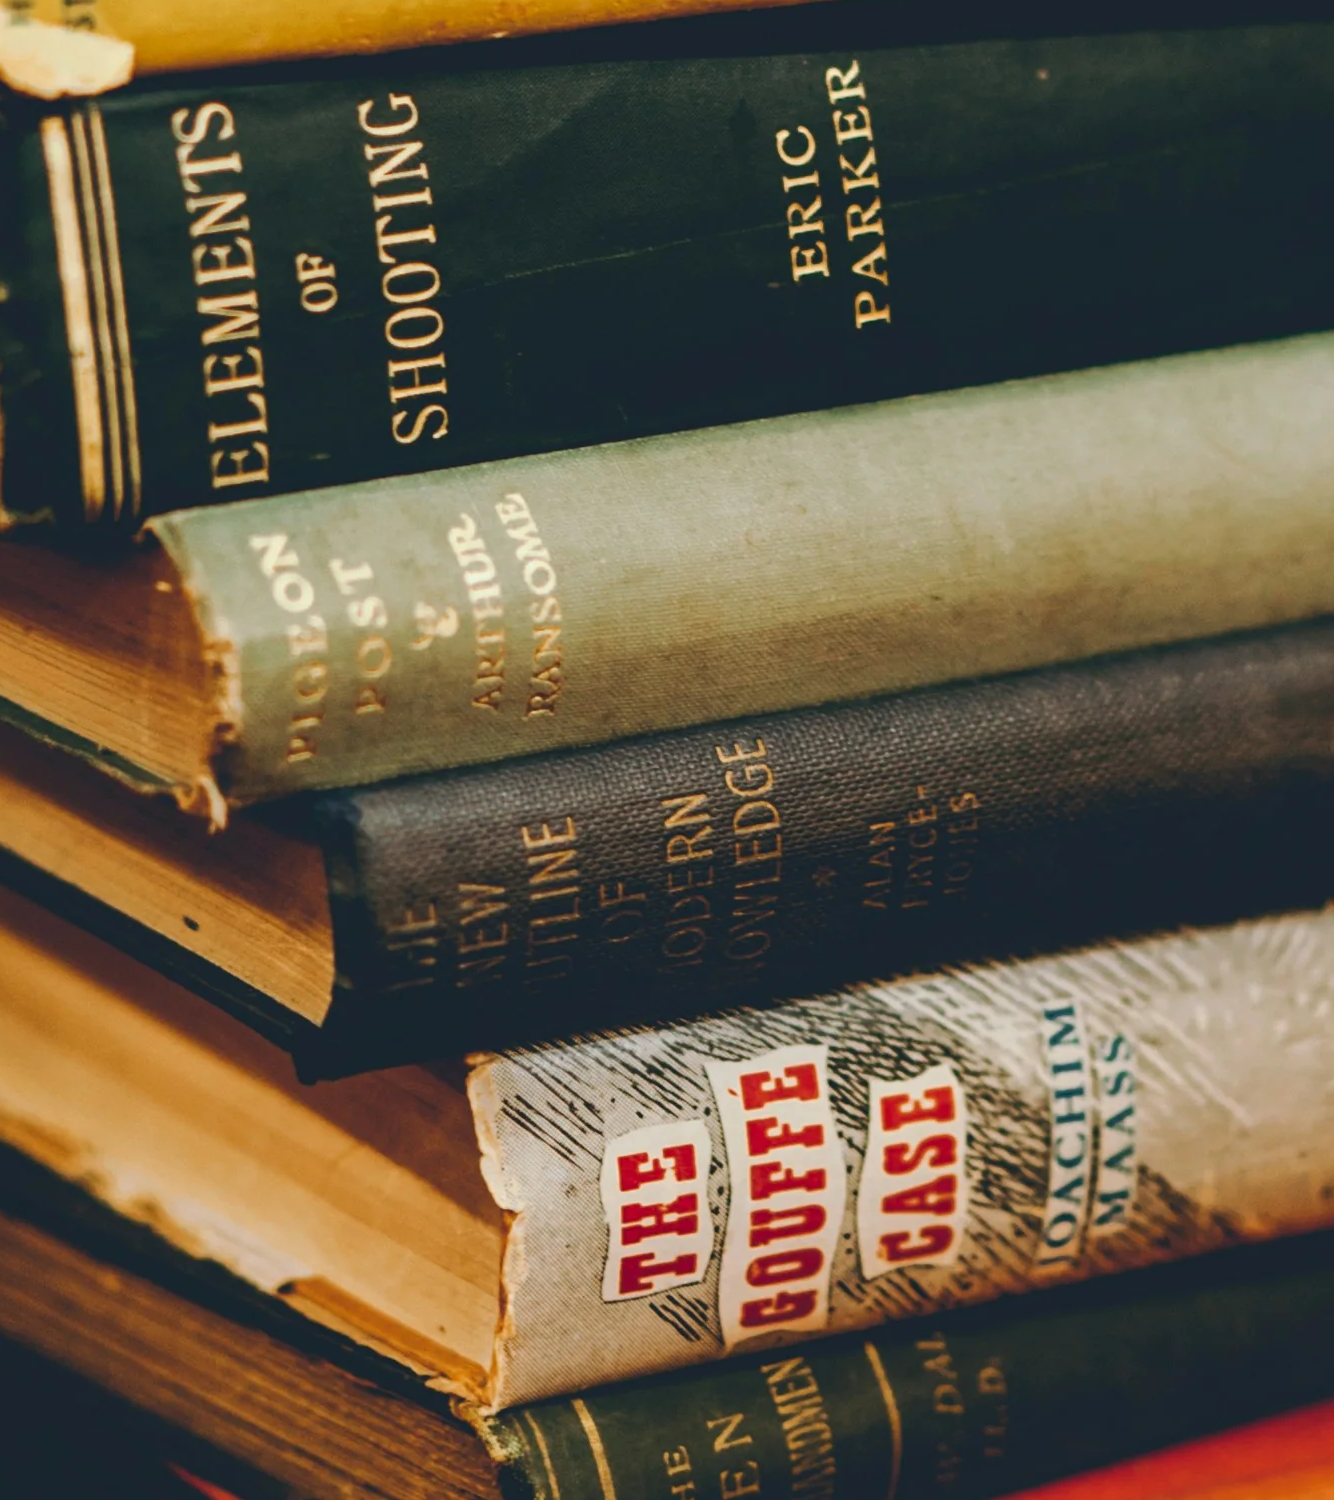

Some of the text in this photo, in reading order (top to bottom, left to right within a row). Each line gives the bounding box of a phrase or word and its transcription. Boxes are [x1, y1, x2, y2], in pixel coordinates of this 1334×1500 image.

[294, 252, 339, 314] OF
[356, 92, 450, 445] SHOOTING
[775, 124, 831, 283] ERIC
[824, 58, 892, 330] PARKER
[170, 101, 270, 490] ELEMENTS
[329, 557, 393, 717] POST
[446, 511, 507, 719] ARTHUR
[494, 492, 564, 723] RANSOME
[598, 880, 649, 945] OF
[616, 1142, 700, 1297] THE
[877, 1085, 958, 1264] CASE
[1036, 1001, 1089, 1271] JOACHIM
[1095, 1030, 1138, 1229] MAASS
